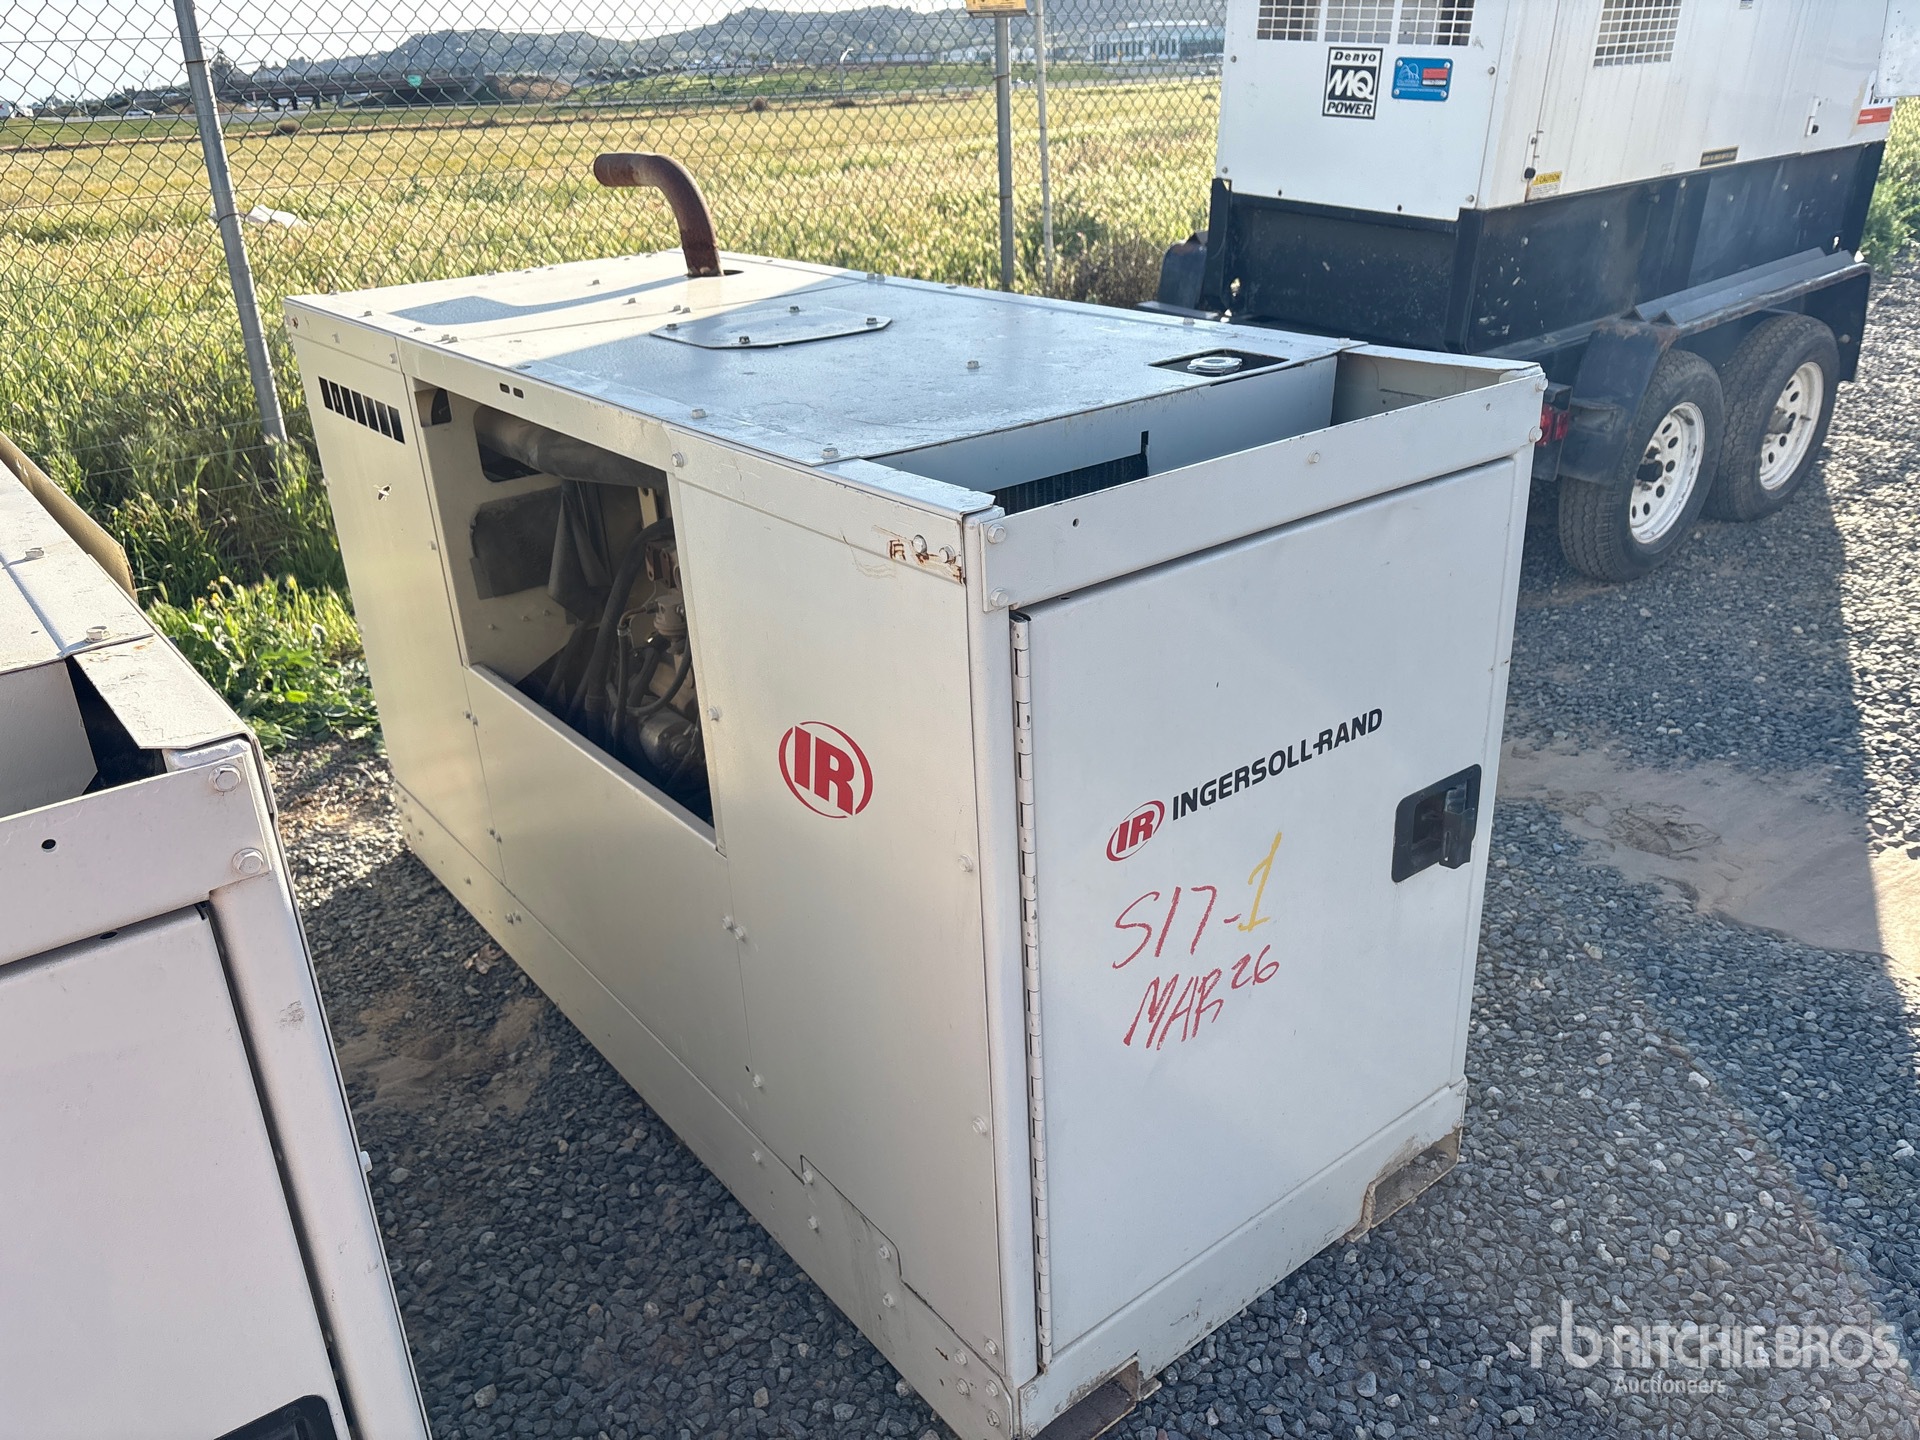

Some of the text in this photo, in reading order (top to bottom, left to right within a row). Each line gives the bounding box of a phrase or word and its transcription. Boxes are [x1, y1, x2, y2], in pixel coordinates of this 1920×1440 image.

[1328, 69, 1374, 100] MQ
[1334, 51, 1377, 64] Denyo
[1326, 102, 1373, 116] POWER
[794, 725, 855, 817] IR
[1172, 708, 1383, 821] INGERSOLL-RAND
[1123, 967, 1225, 1051] MAR
